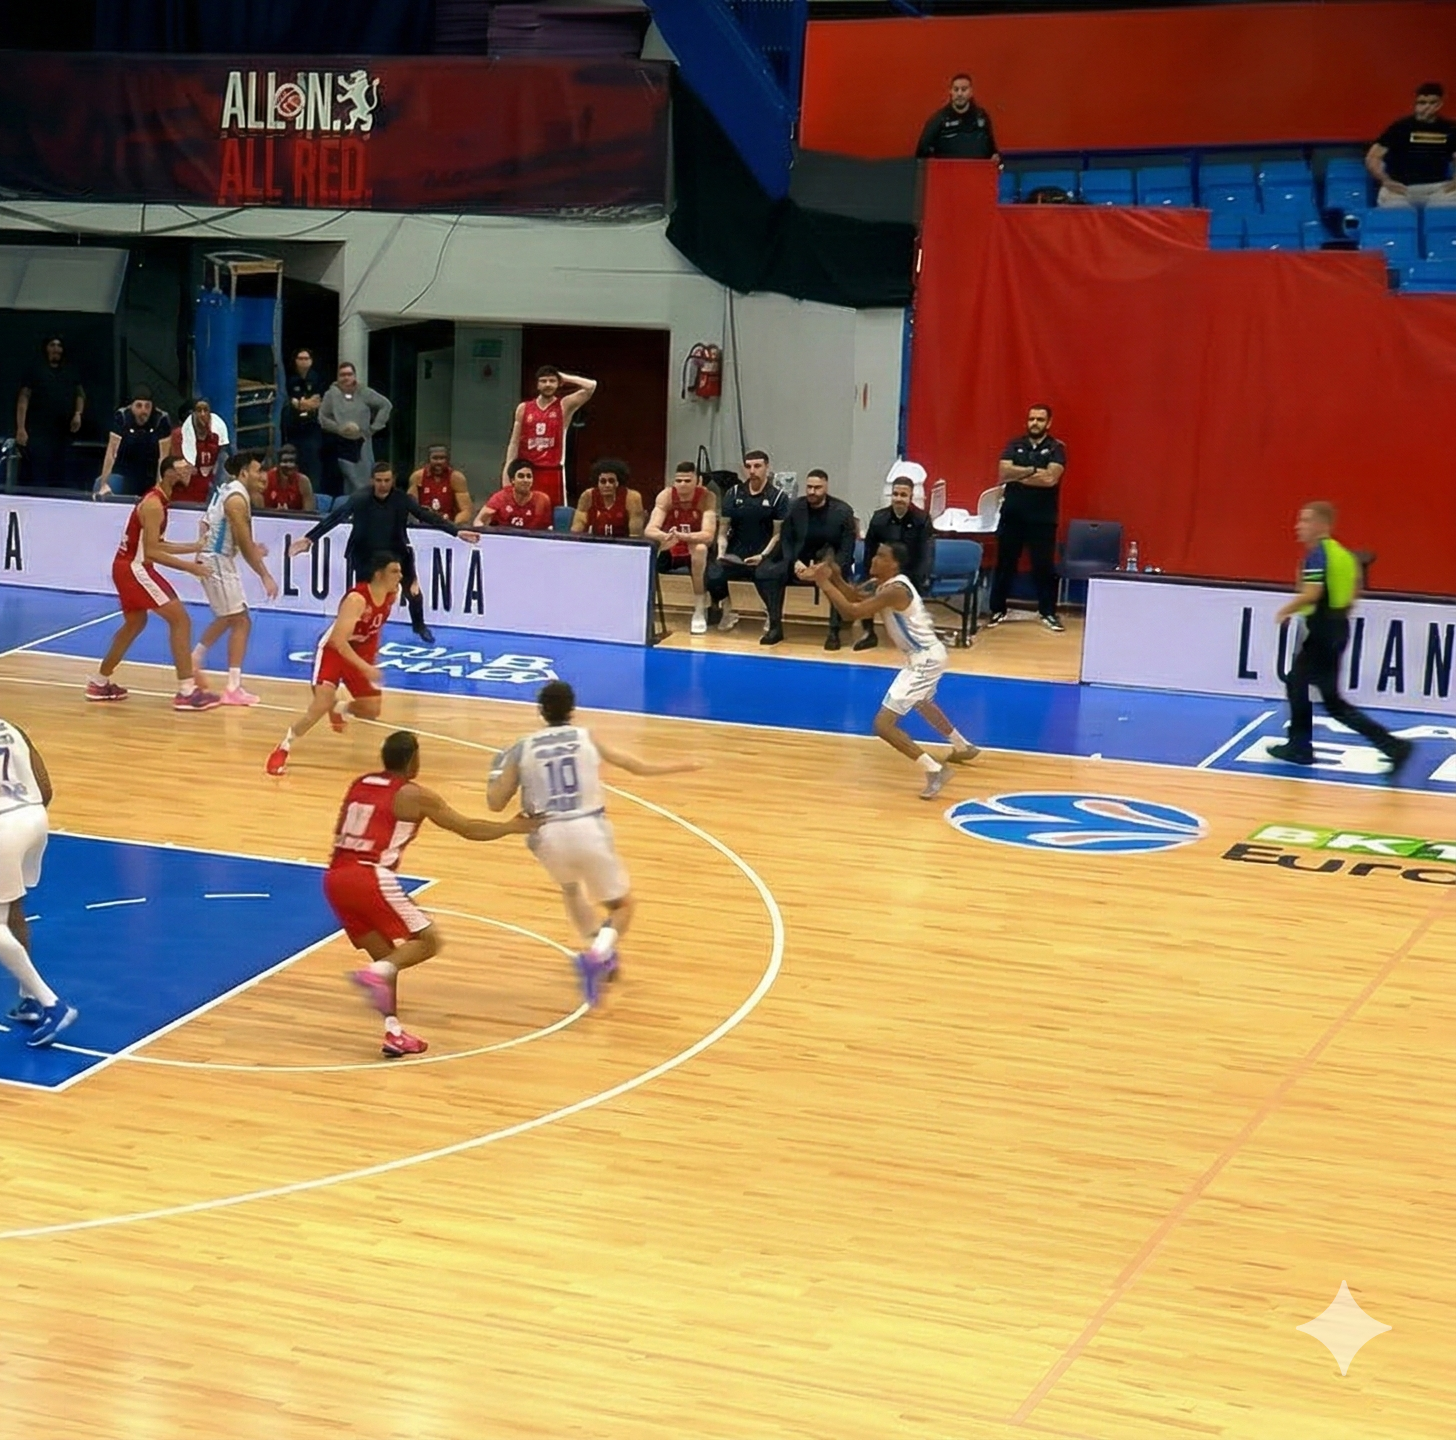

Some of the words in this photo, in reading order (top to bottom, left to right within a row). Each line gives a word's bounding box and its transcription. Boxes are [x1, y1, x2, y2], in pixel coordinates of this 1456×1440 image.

[221, 71, 286, 130] ALL
[218, 137, 283, 203] ALL
[283, 534, 485, 616] LUNA
